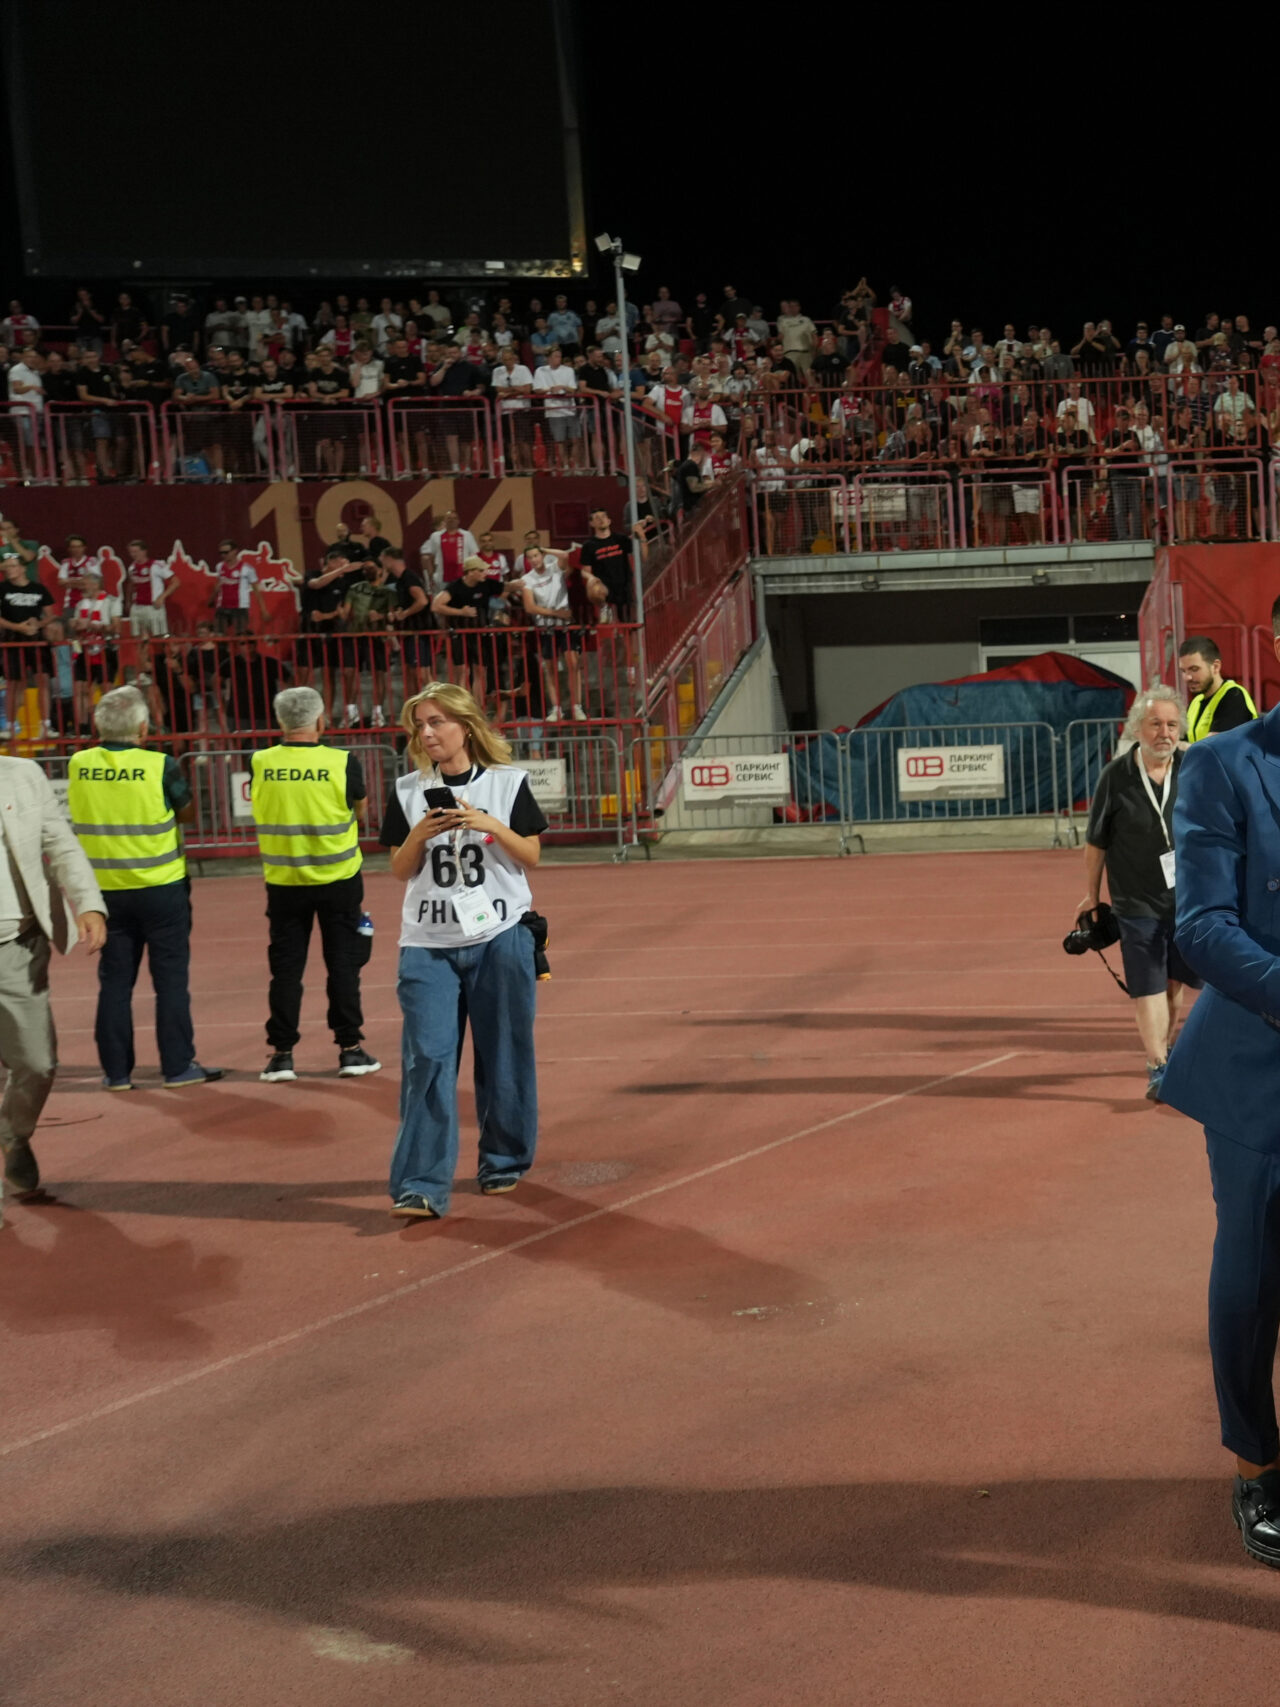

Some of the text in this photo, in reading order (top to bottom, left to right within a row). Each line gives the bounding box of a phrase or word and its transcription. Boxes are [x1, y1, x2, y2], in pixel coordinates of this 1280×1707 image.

[949, 753, 994, 763] ПАРКИНГ
[735, 763, 780, 772] ПАРКИНГ
[949, 763, 987, 773] СЕРВИС
[79, 768, 145, 781] REDAR
[264, 769, 329, 781] REDAR
[736, 773, 774, 782] СЕРВИС
[431, 844, 486, 888] 63
